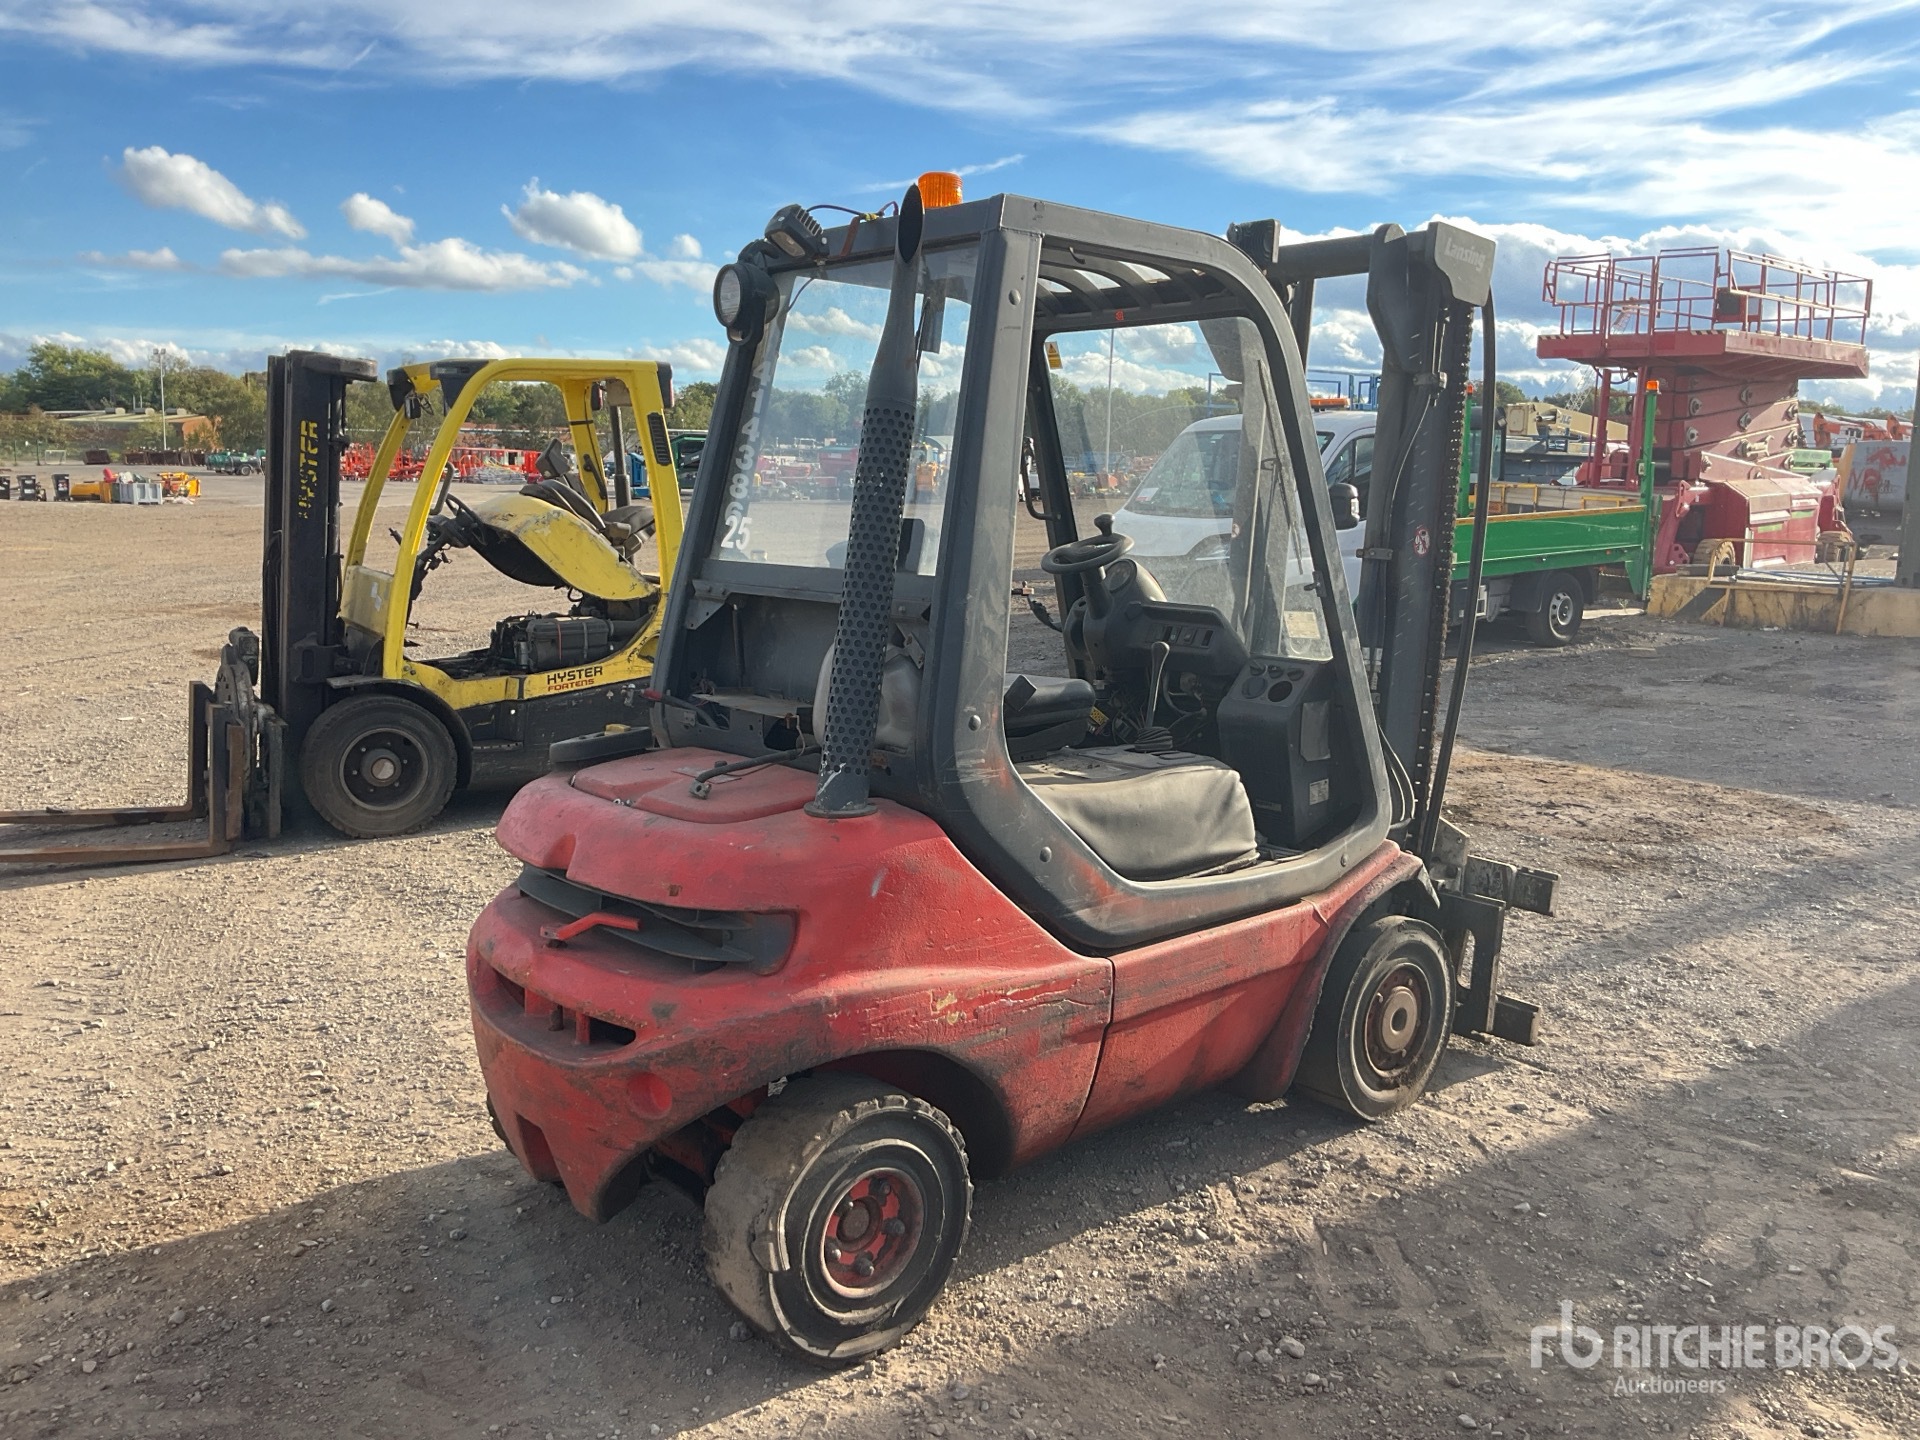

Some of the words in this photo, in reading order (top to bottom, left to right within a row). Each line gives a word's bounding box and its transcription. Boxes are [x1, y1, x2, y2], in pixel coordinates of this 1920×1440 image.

[1443, 237, 1486, 272] Lansing
[721, 515, 752, 550] 25
[547, 665, 603, 685] HYSTER
[547, 678, 595, 692] FORTENS
